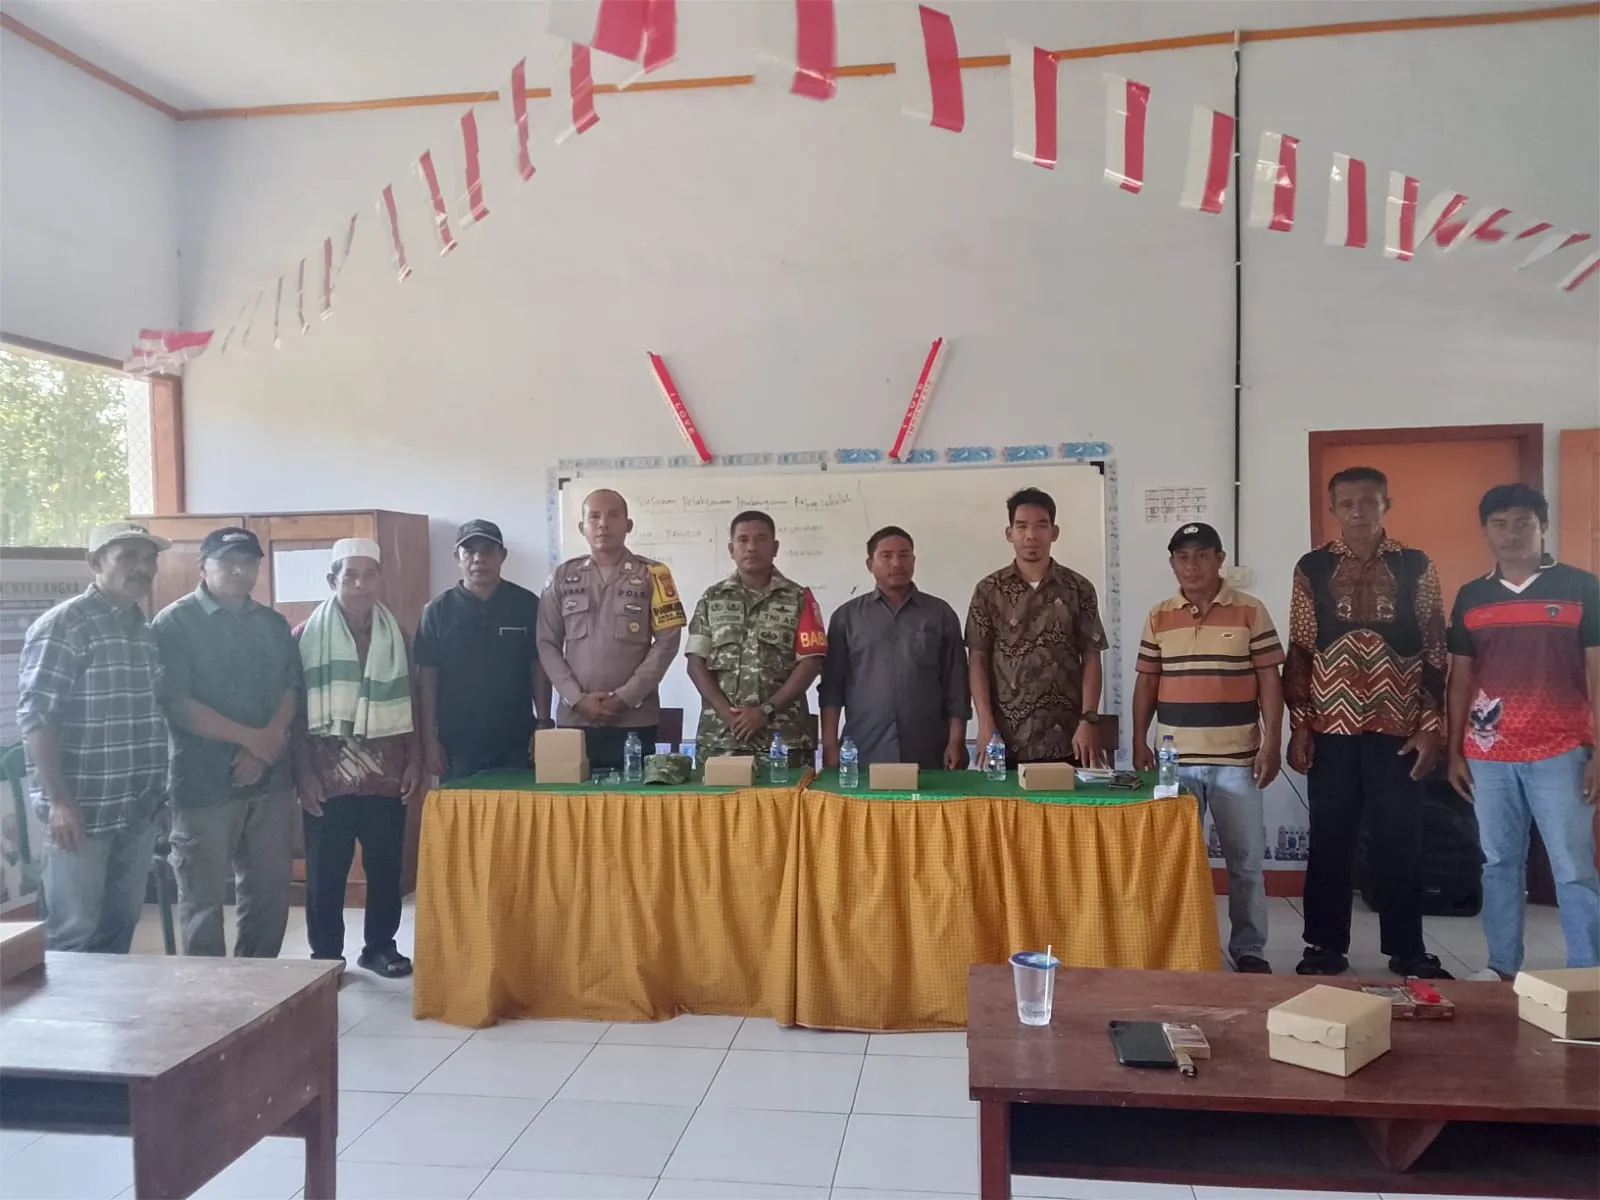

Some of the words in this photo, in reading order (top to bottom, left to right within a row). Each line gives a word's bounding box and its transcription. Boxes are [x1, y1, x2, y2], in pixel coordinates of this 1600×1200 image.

[907, 383, 924, 418] LOVE
[675, 402, 696, 434] LOVE
[764, 613, 780, 621] TNI
[783, 616, 797, 626] AD
